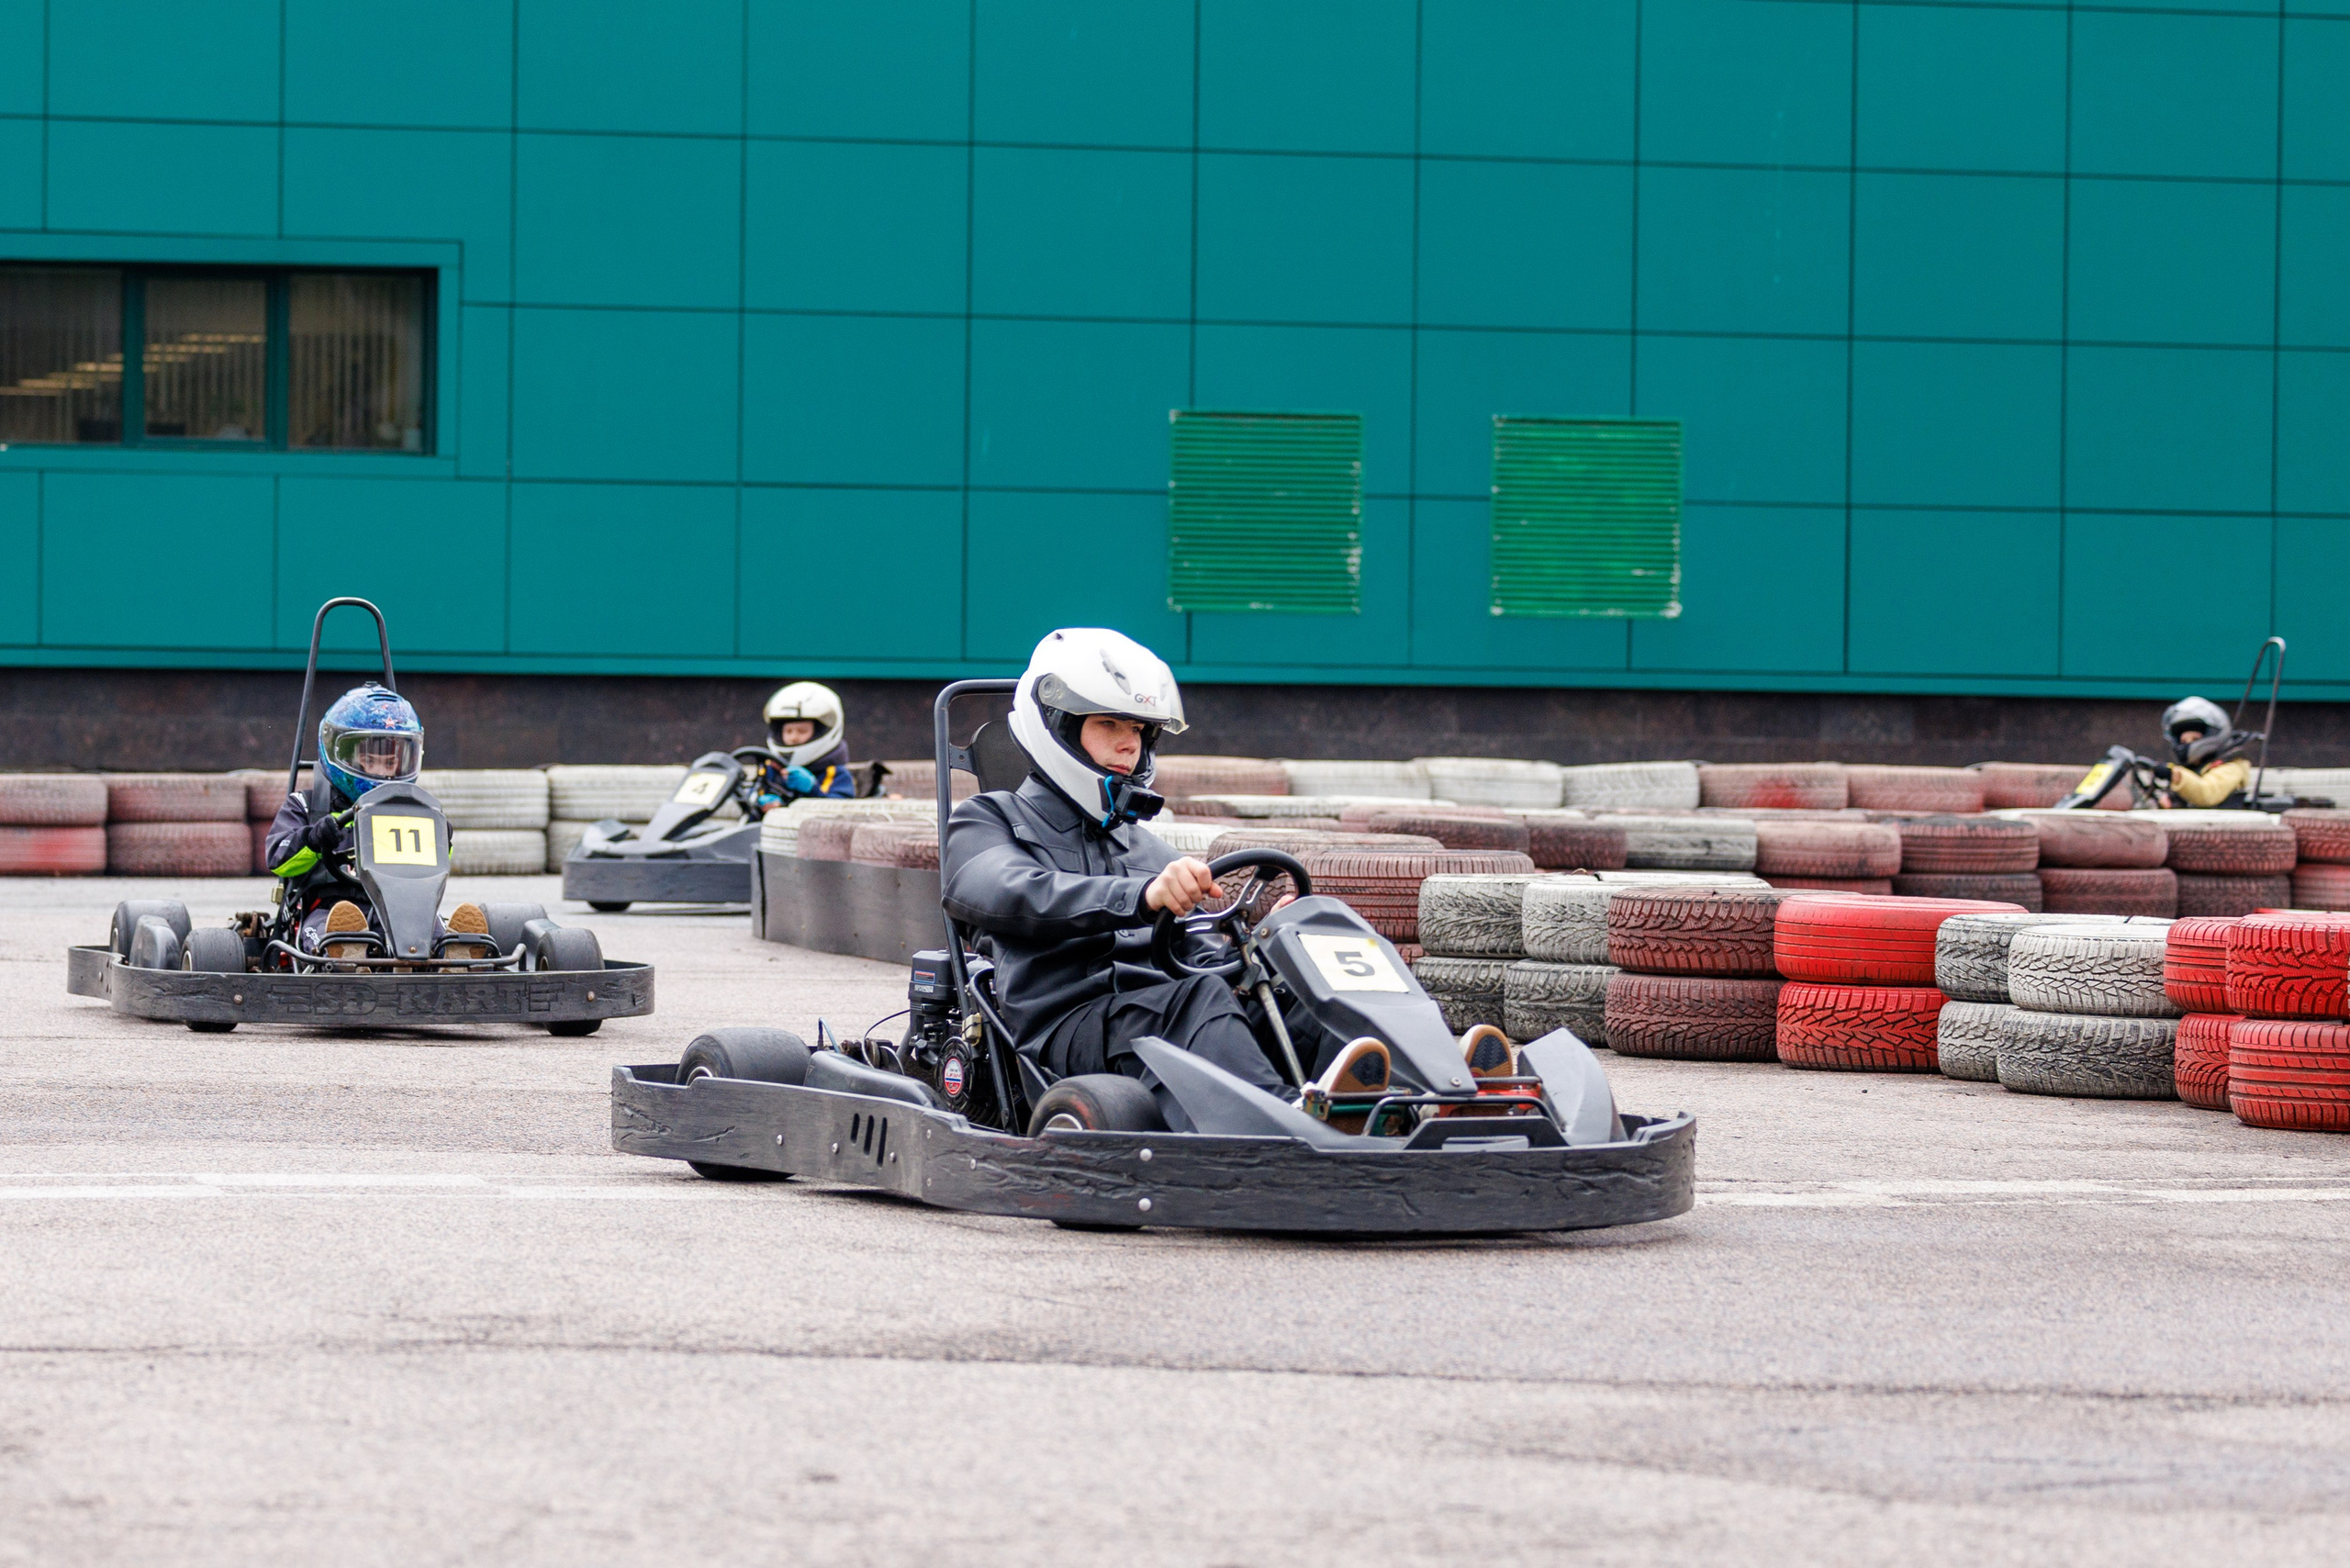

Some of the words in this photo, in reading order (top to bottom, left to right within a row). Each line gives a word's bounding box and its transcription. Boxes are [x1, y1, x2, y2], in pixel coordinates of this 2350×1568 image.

[1135, 693, 1157, 707] GXT
[388, 828, 421, 853] 11
[1334, 951, 1375, 978] 5
